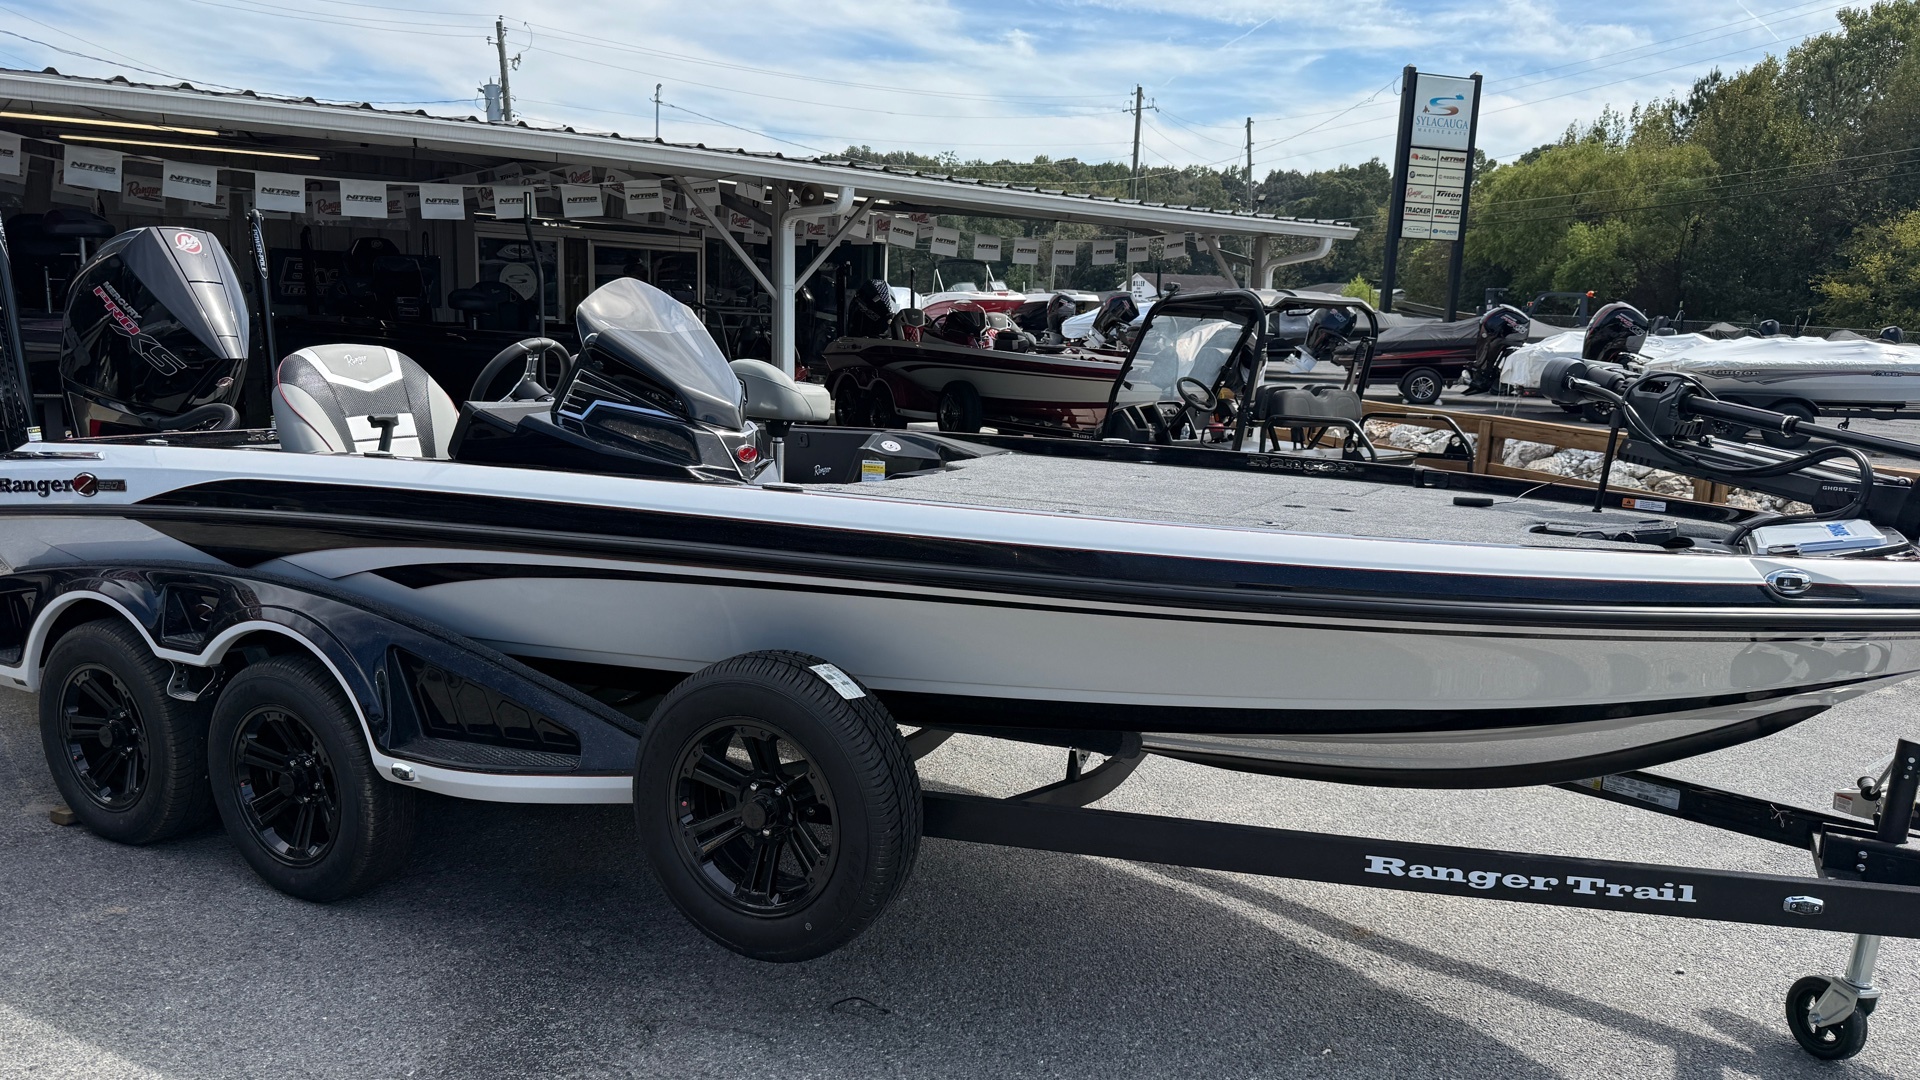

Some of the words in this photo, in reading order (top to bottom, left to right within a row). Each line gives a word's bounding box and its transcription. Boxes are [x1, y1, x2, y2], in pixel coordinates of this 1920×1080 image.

[1416, 115, 1468, 130] SYLACAUGA
[1417, 127, 1445, 135] MARINE
[71, 161, 116, 172] NITRO
[169, 174, 212, 185] NITRO
[127, 181, 161, 196] Ranger
[261, 187, 300, 196] NITRO
[1436, 190, 1462, 198] Triton
[346, 194, 382, 202] NITRO
[630, 192, 659, 200] NITRO
[315, 199, 341, 214] Range
[1404, 206, 1431, 214] TRACKER
[1434, 208, 1461, 216] TRACKER
[893, 227, 915, 236] NITRO
[935, 237, 957, 246] NITRO
[102, 281, 143, 320] MERCURY
[92, 285, 142, 336] PRO
[109, 323, 188, 377] XS
[343, 354, 368, 367] Ranger
[813, 464, 832, 477] Ranger
[0, 477, 74, 498] Ranger
[1363, 854, 1559, 891] Ranger
[1566, 874, 1697, 904] Trail
